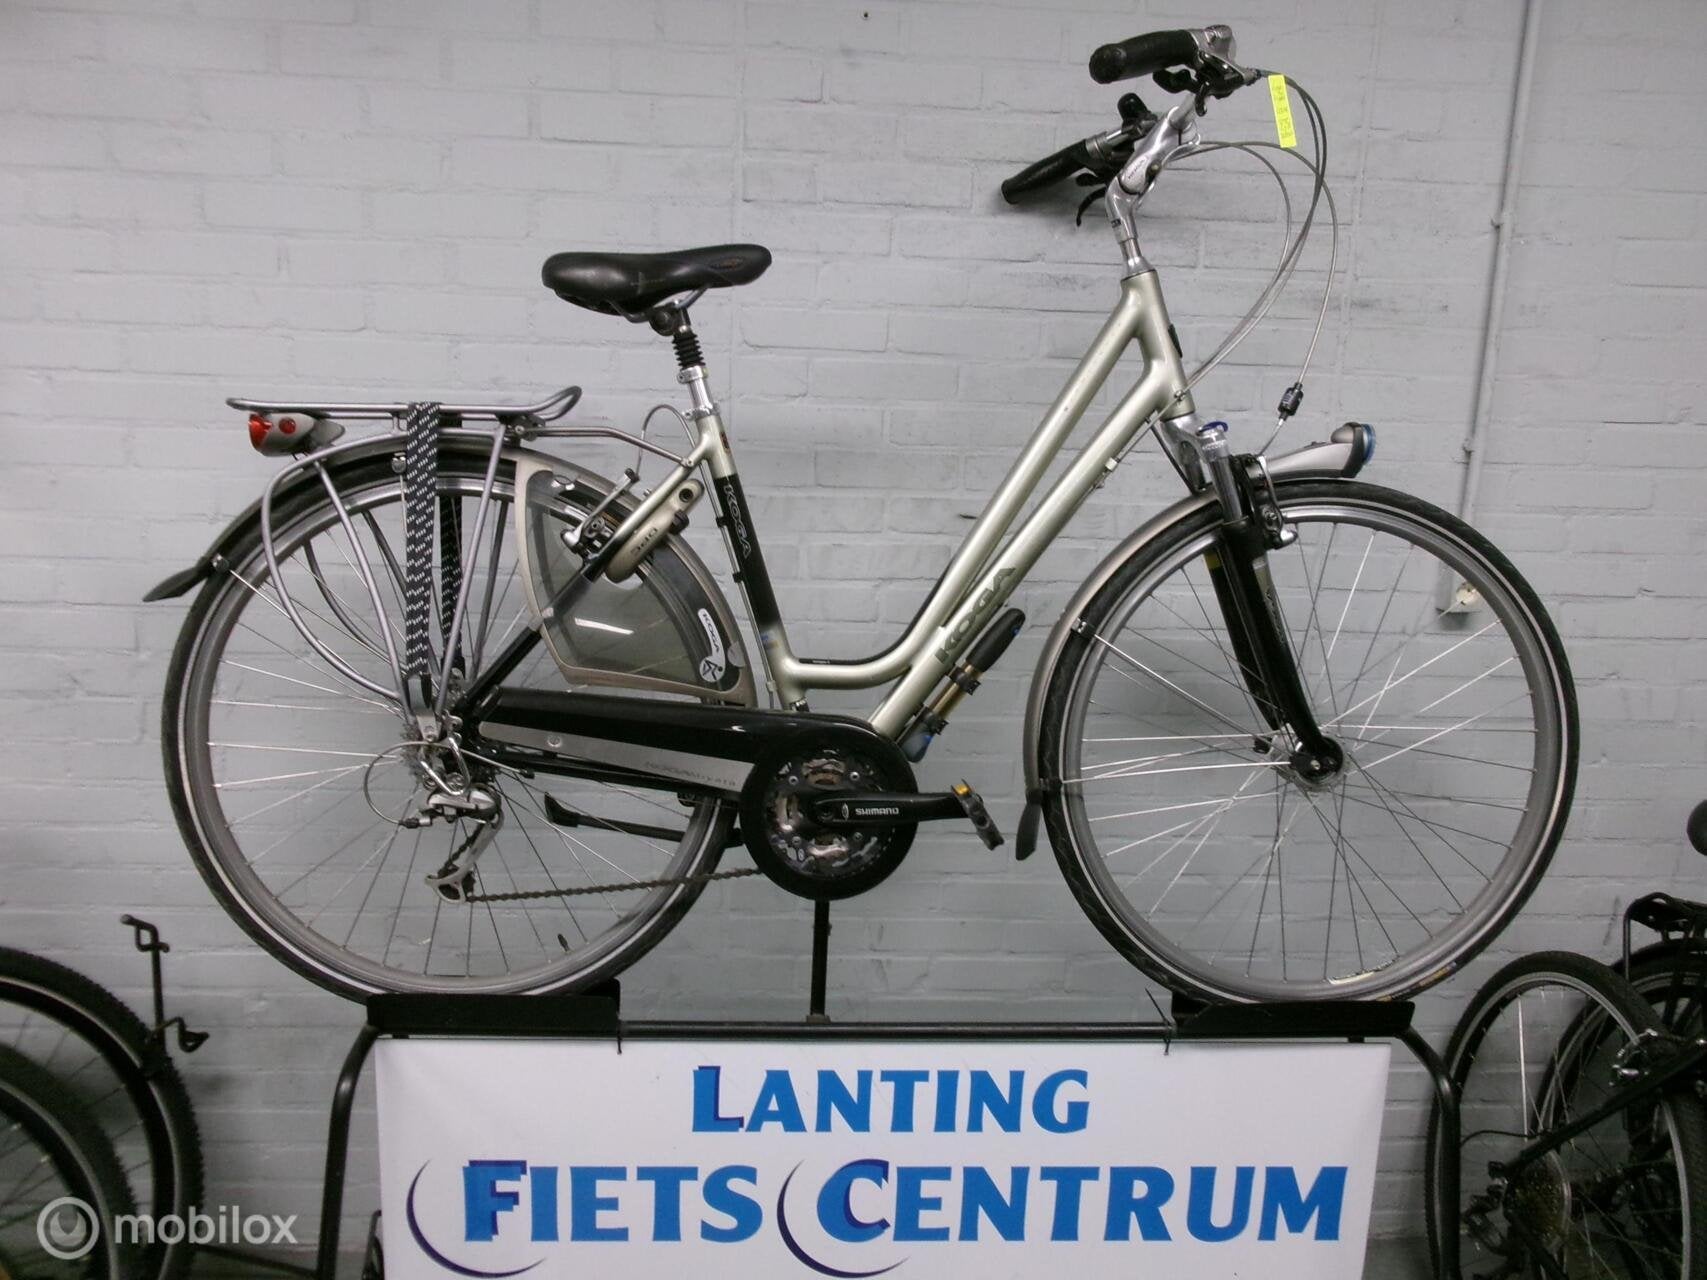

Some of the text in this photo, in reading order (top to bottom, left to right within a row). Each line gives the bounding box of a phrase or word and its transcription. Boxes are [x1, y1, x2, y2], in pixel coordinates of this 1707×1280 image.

[723, 484, 751, 559] KOGA
[934, 567, 1016, 664] KOGA
[855, 807, 899, 816] SHIMANO
[691, 1065, 1090, 1135] LANTING
[463, 1159, 1348, 1244] FIETS CENTRUM
